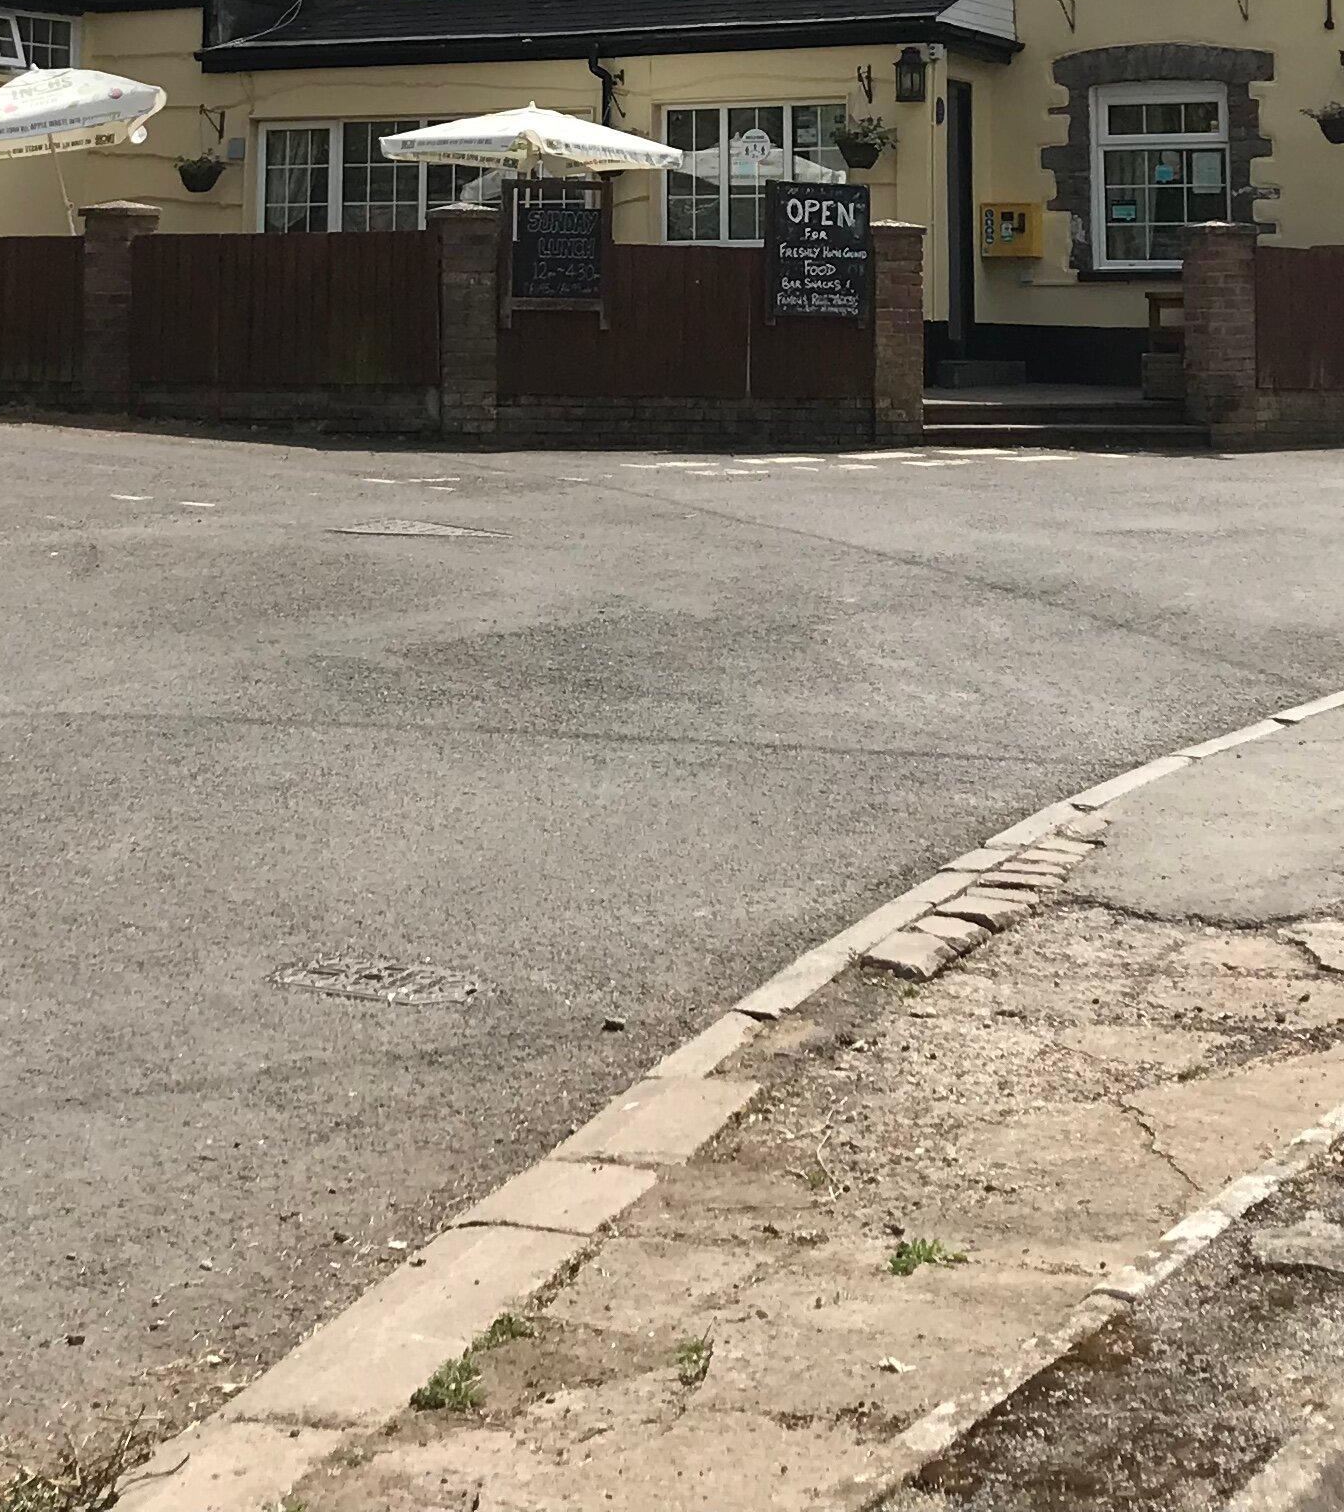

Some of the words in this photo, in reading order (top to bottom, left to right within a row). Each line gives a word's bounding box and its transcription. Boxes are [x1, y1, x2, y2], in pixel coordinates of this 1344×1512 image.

[786, 198, 856, 228] OPEN
[527, 210, 599, 235] SUNDAY
[804, 227, 828, 241] FOR
[537, 237, 596, 259] LUNCH
[779, 242, 821, 258] FRESHLY
[804, 259, 837, 276] FOOD
[781, 276, 802, 290] BAR
[804, 277, 842, 291] SNACKS
